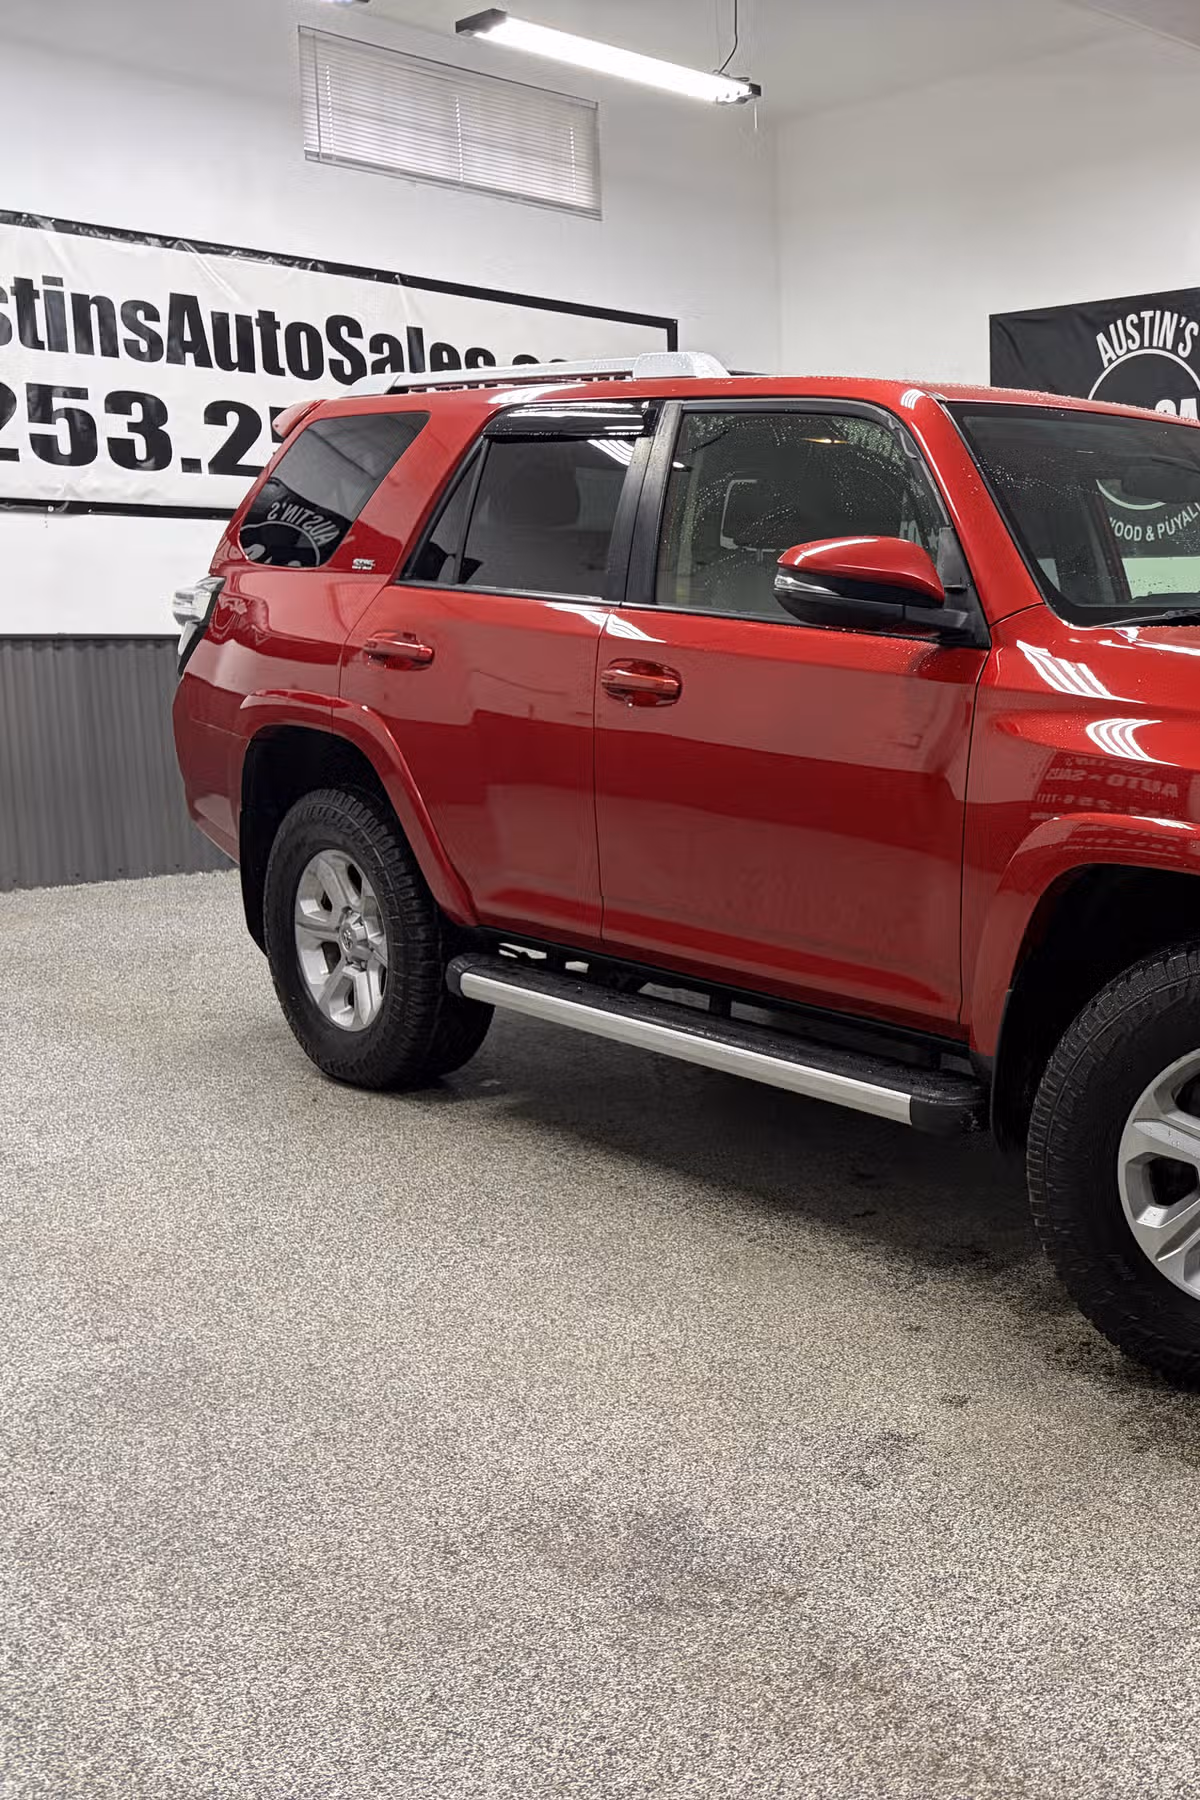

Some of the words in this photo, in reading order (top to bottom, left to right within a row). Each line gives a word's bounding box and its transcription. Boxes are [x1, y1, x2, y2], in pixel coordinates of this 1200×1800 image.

[1095, 310, 1199, 367] AUSTIN'S
[0, 382, 284, 476] 53.2
[1145, 527, 1155, 541] &
